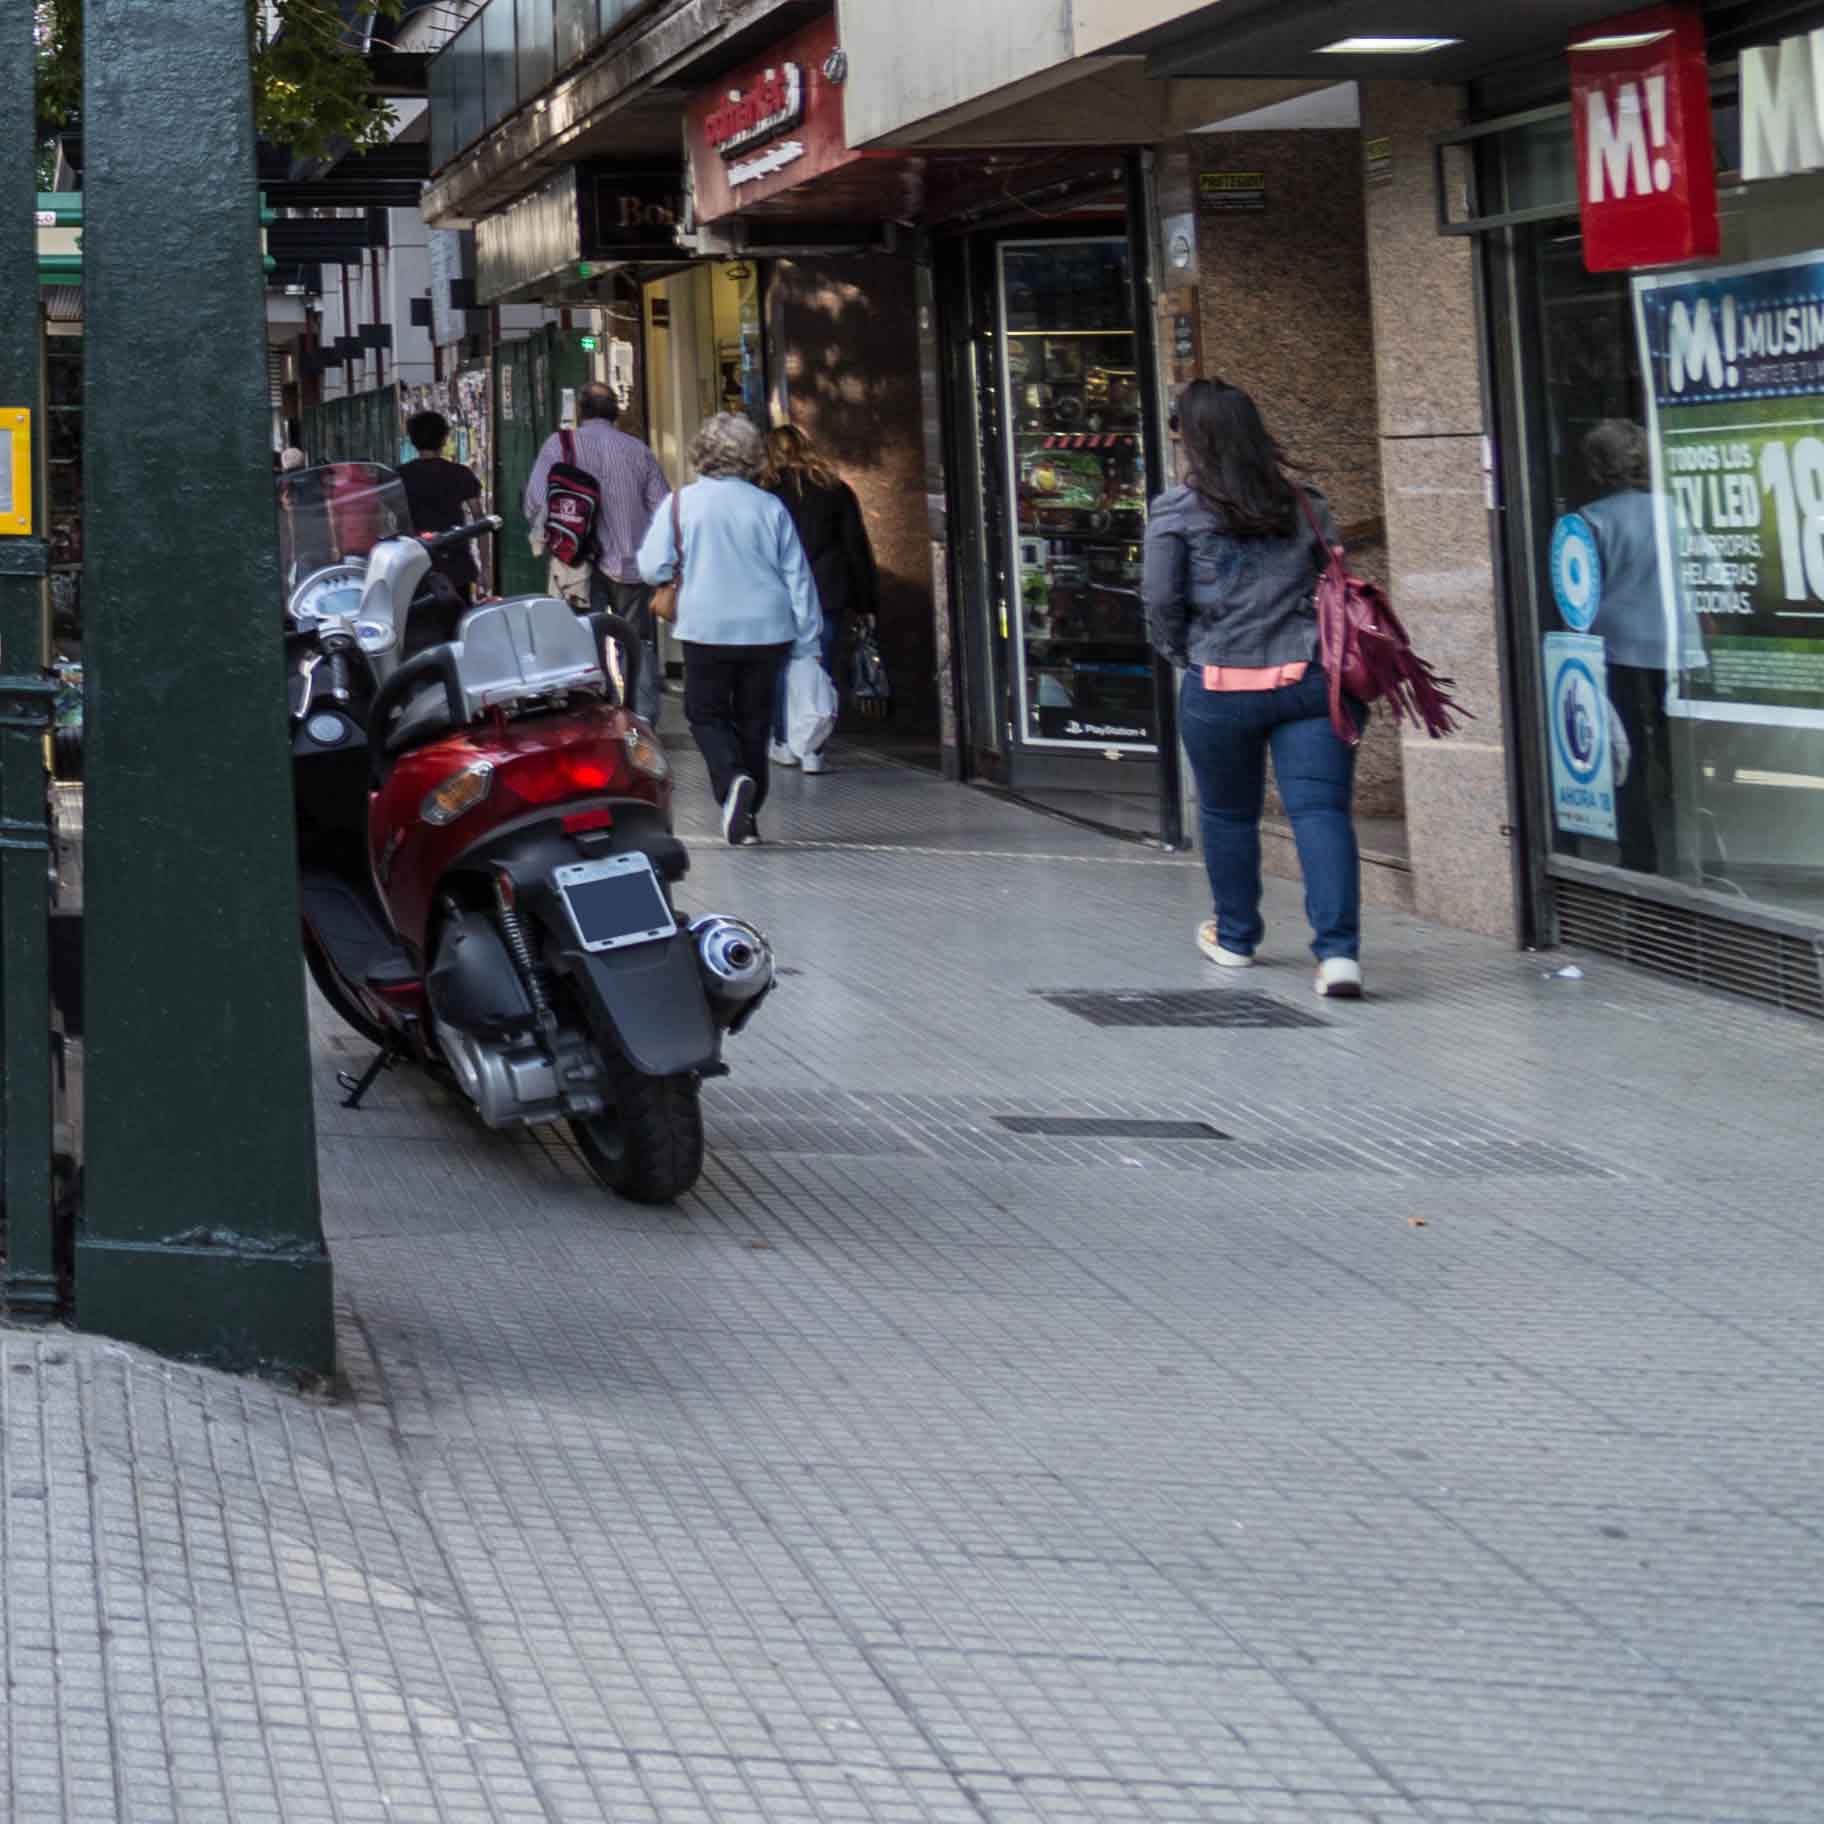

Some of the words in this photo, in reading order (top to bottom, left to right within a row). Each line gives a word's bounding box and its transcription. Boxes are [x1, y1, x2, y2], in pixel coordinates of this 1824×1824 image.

[1587, 75, 1672, 204] M!
[1740, 26, 1824, 181] M
[1670, 294, 1740, 393] M!
[1671, 474, 1704, 530] TV
[1708, 472, 1761, 529] LED
